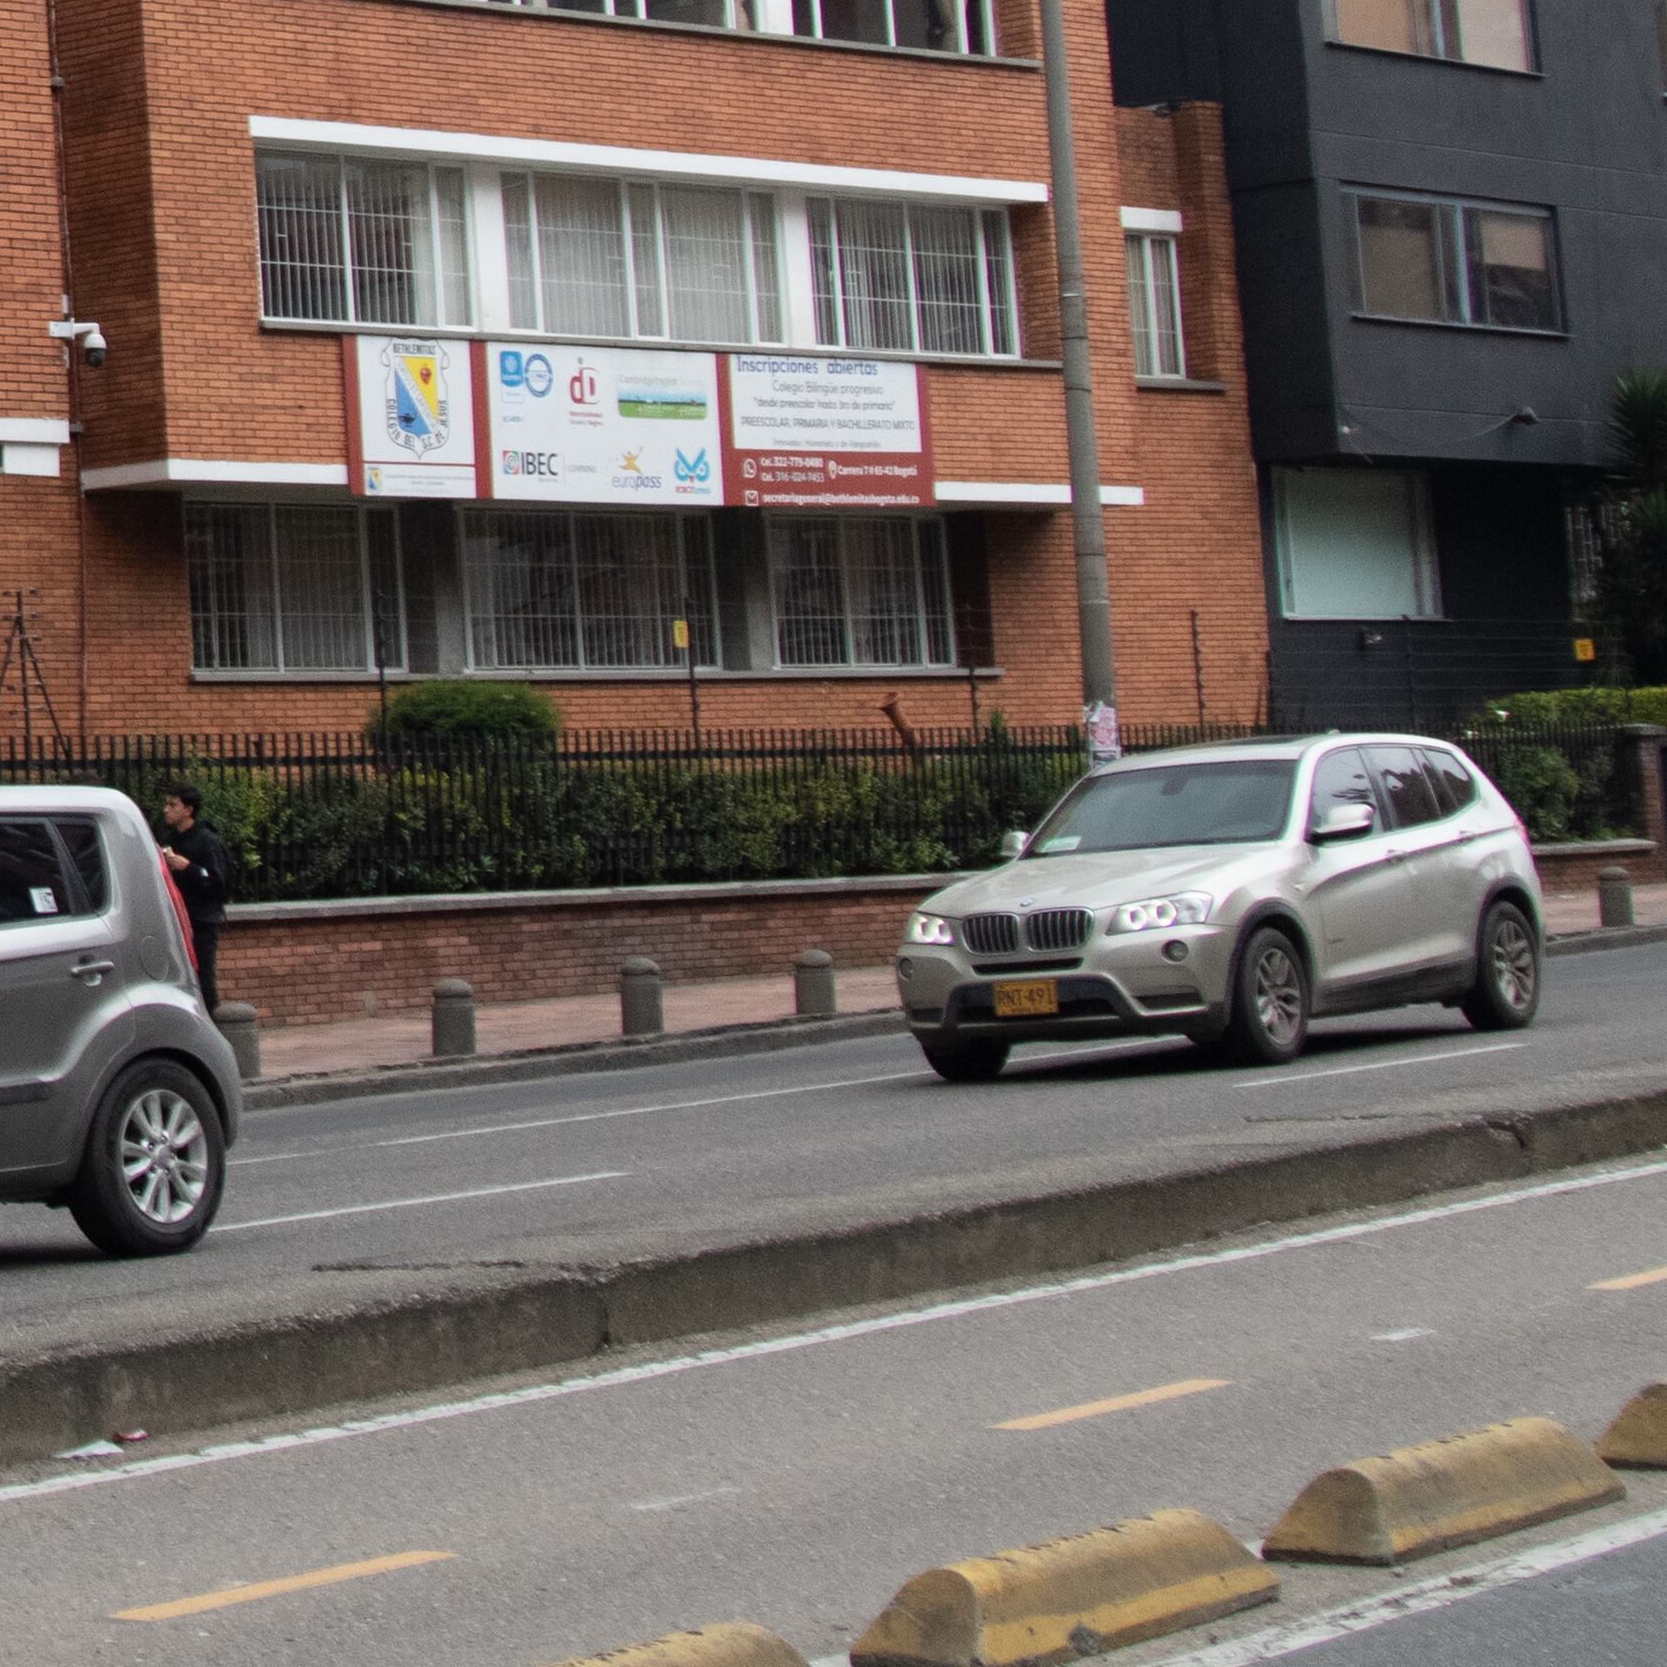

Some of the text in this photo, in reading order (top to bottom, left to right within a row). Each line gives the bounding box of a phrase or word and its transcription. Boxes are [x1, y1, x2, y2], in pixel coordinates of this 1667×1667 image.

[393, 343, 436, 354] BETHLEMITAS
[737, 357, 878, 377] Inscripciones abiertas
[521, 452, 558, 475] IBEC
[612, 474, 662, 492] europass
